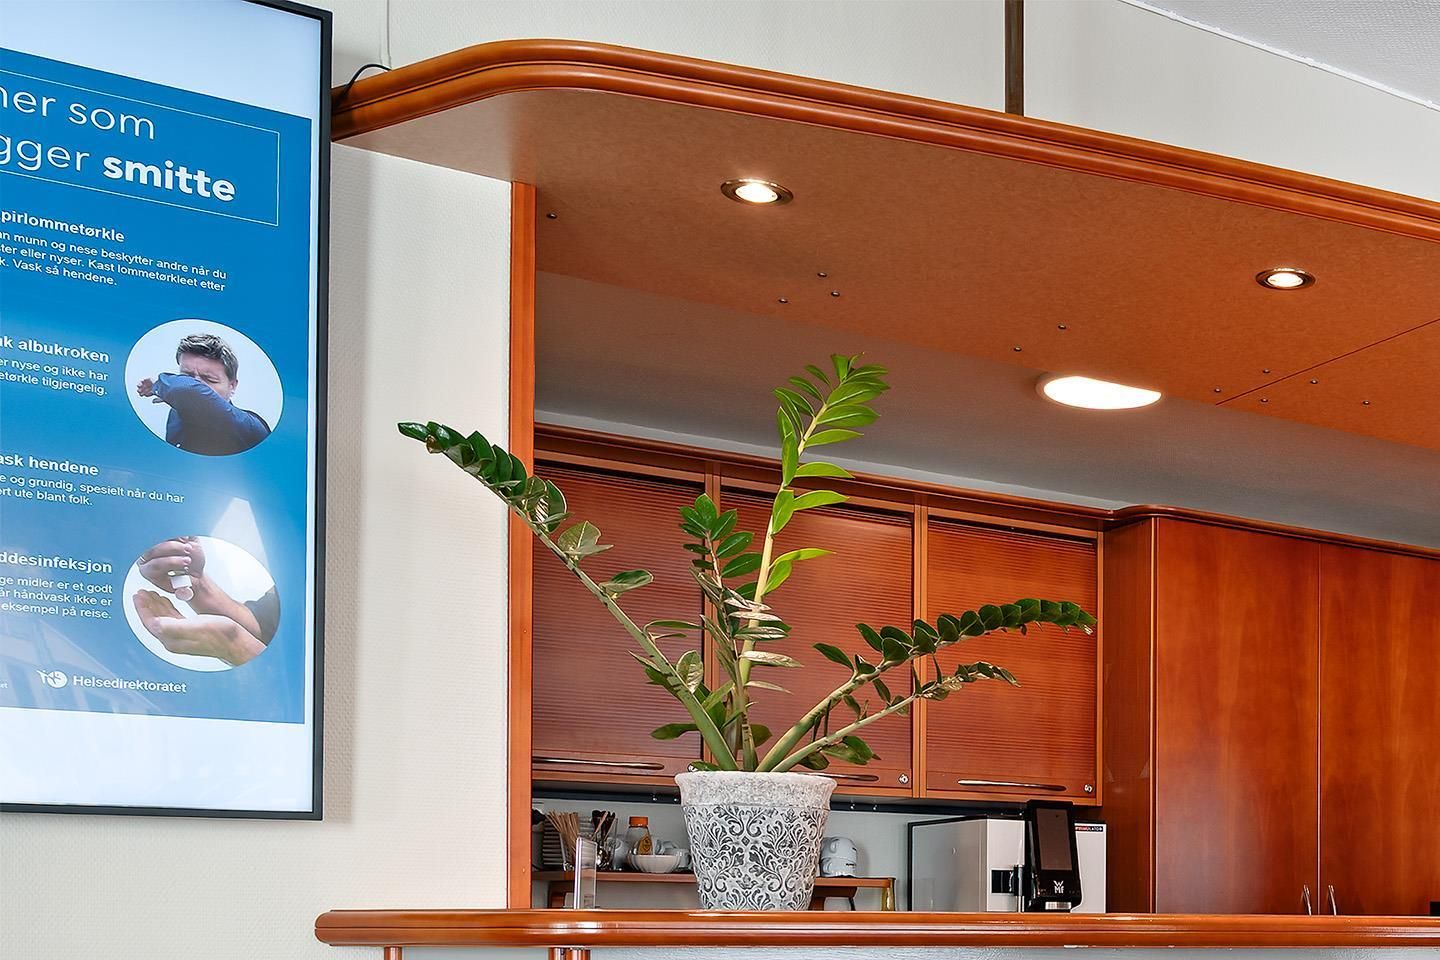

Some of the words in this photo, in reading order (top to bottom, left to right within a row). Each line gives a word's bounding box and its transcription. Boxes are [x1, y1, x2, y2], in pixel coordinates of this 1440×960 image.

[68, 103, 155, 140] som
[103, 156, 236, 201] smitte
[1, 210, 125, 242] pirlommetørkle
[0, 244, 17, 254] ter
[20, 248, 47, 260] eller
[49, 253, 85, 265] nyser.
[88, 259, 115, 272] Kast
[117, 264, 198, 287] lommetørkleet
[200, 281, 226, 291] etter
[13, 234, 48, 247] munn
[51, 241, 66, 252] og
[69, 245, 98, 256] nese
[101, 249, 154, 266] beskytter
[156, 260, 189, 273] andre
[191, 265, 210, 276] når
[212, 269, 227, 280] du
[13, 259, 42, 272] Vask
[45, 265, 60, 276] så
[63, 268, 118, 285] hendene.
[18, 339, 109, 363] albukroken
[11, 360, 40, 371] nyse
[43, 365, 59, 375] og
[62, 366, 86, 378] ikke
[89, 370, 108, 381] har
[42, 376, 108, 396] tilgjengelig.
[29, 456, 99, 476] hendene
[0, 487, 12, 497] rt
[14, 489, 33, 499] ute
[37, 490, 66, 503] blant
[69, 494, 93, 506] folk.
[10, 476, 25, 486] og
[80, 483, 125, 497] spesielt
[127, 488, 146, 499] når
[148, 491, 163, 501] du
[166, 492, 185, 503] har
[17, 577, 54, 588] midler
[57, 581, 70, 590] er
[72, 582, 84, 591] et
[87, 584, 113, 594] godt
[13, 589, 71, 603] håndvask
[74, 594, 98, 605] ikke
[100, 598, 113, 606] er
[1, 602, 59, 615] eksempel
[62, 606, 77, 617] på
[80, 609, 112, 619] reise.
[73, 675, 187, 693] Helsedirektoratet
